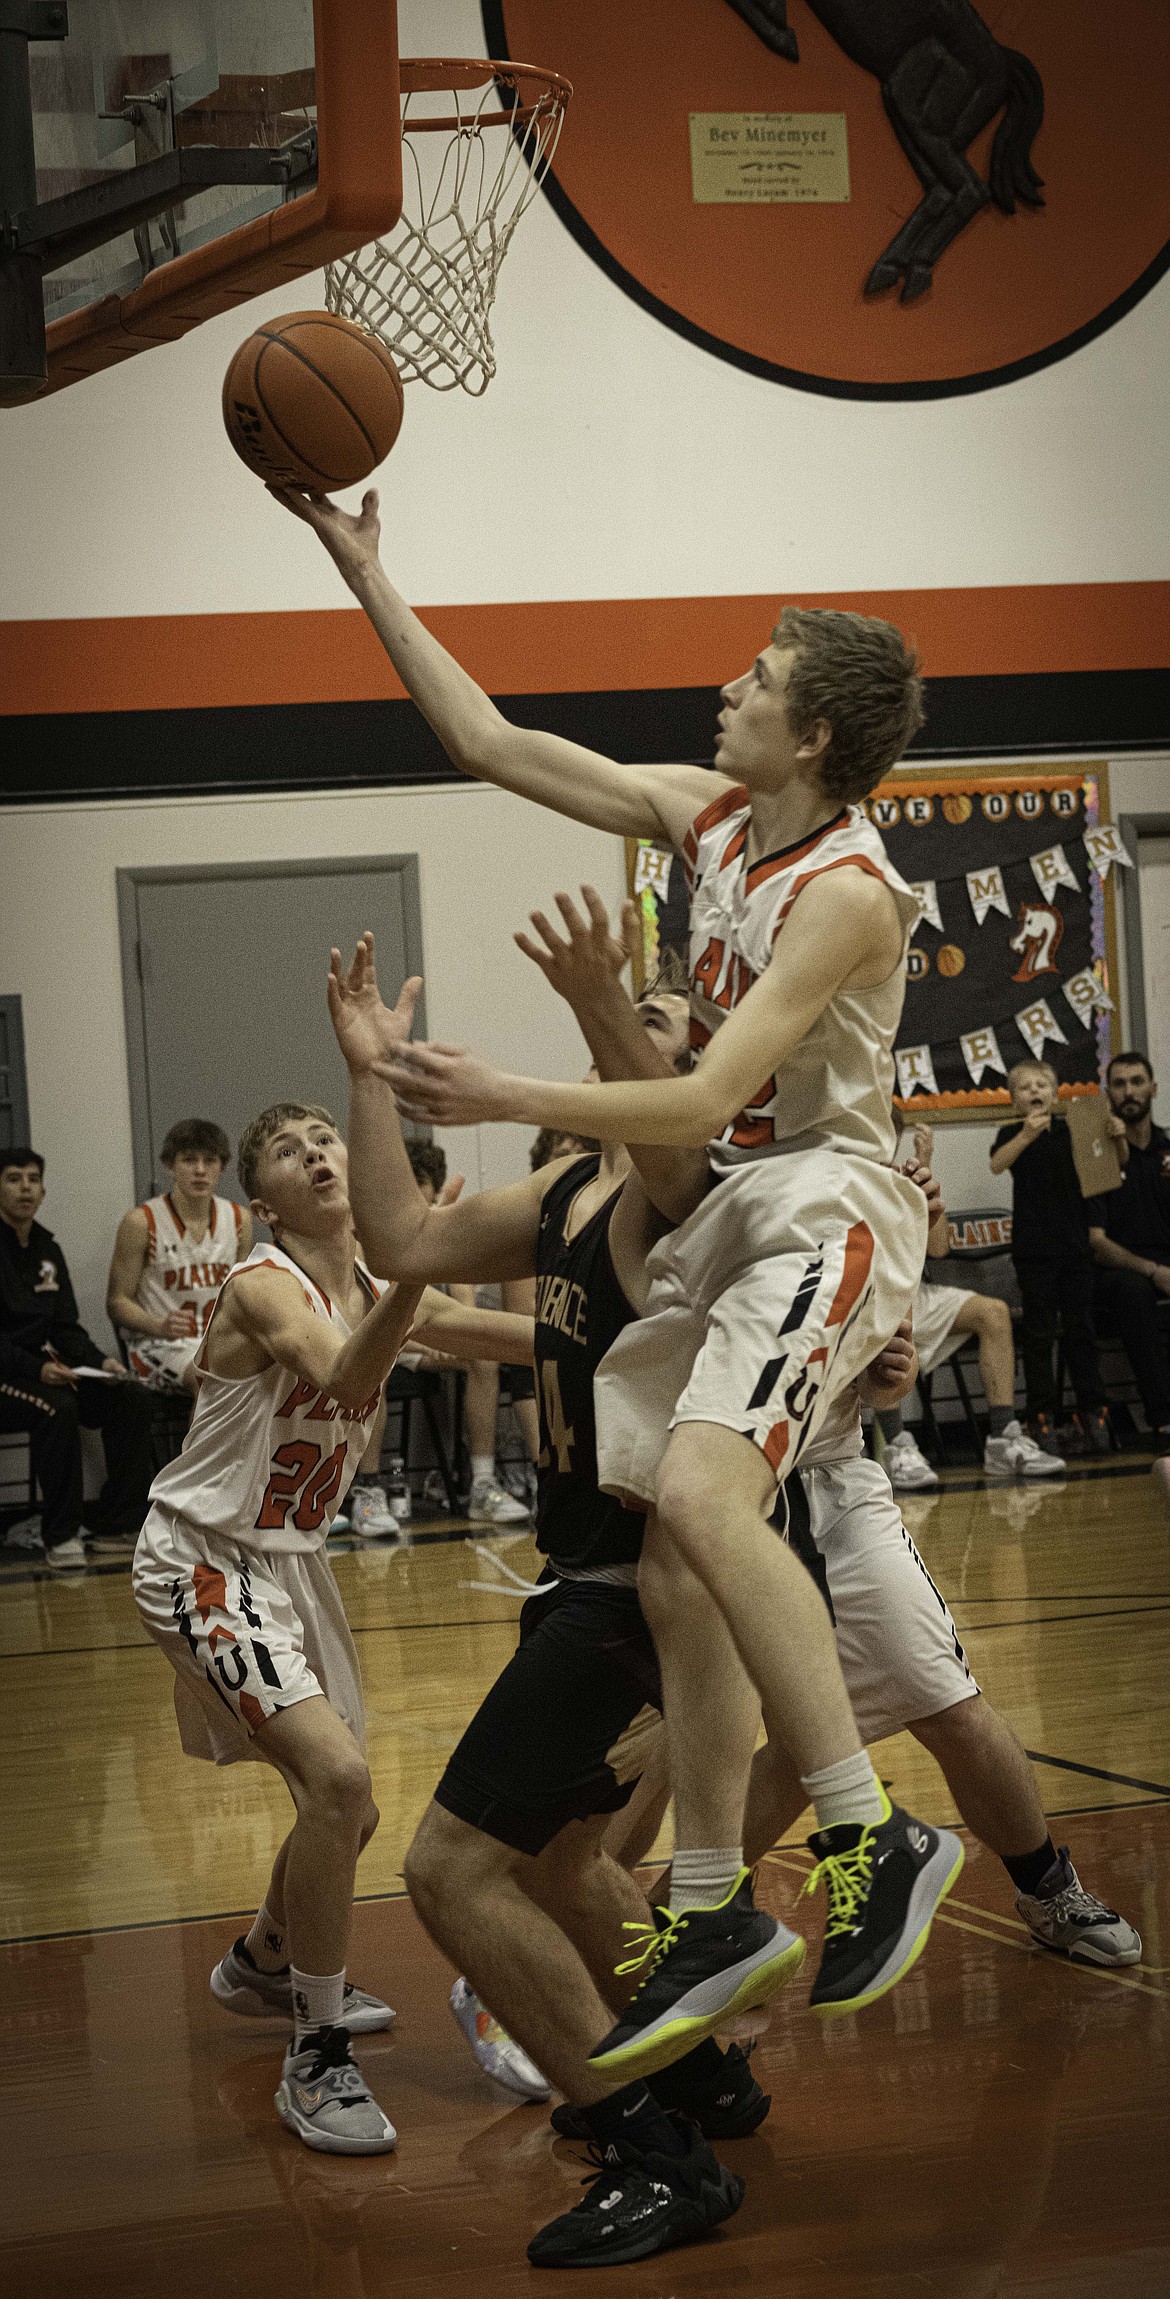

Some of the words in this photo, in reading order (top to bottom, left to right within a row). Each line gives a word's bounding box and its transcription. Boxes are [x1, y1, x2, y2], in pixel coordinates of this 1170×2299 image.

[709, 127, 740, 142] Bev
[989, 790, 1073, 817] OUR
[253, 1440, 349, 1531] 20
